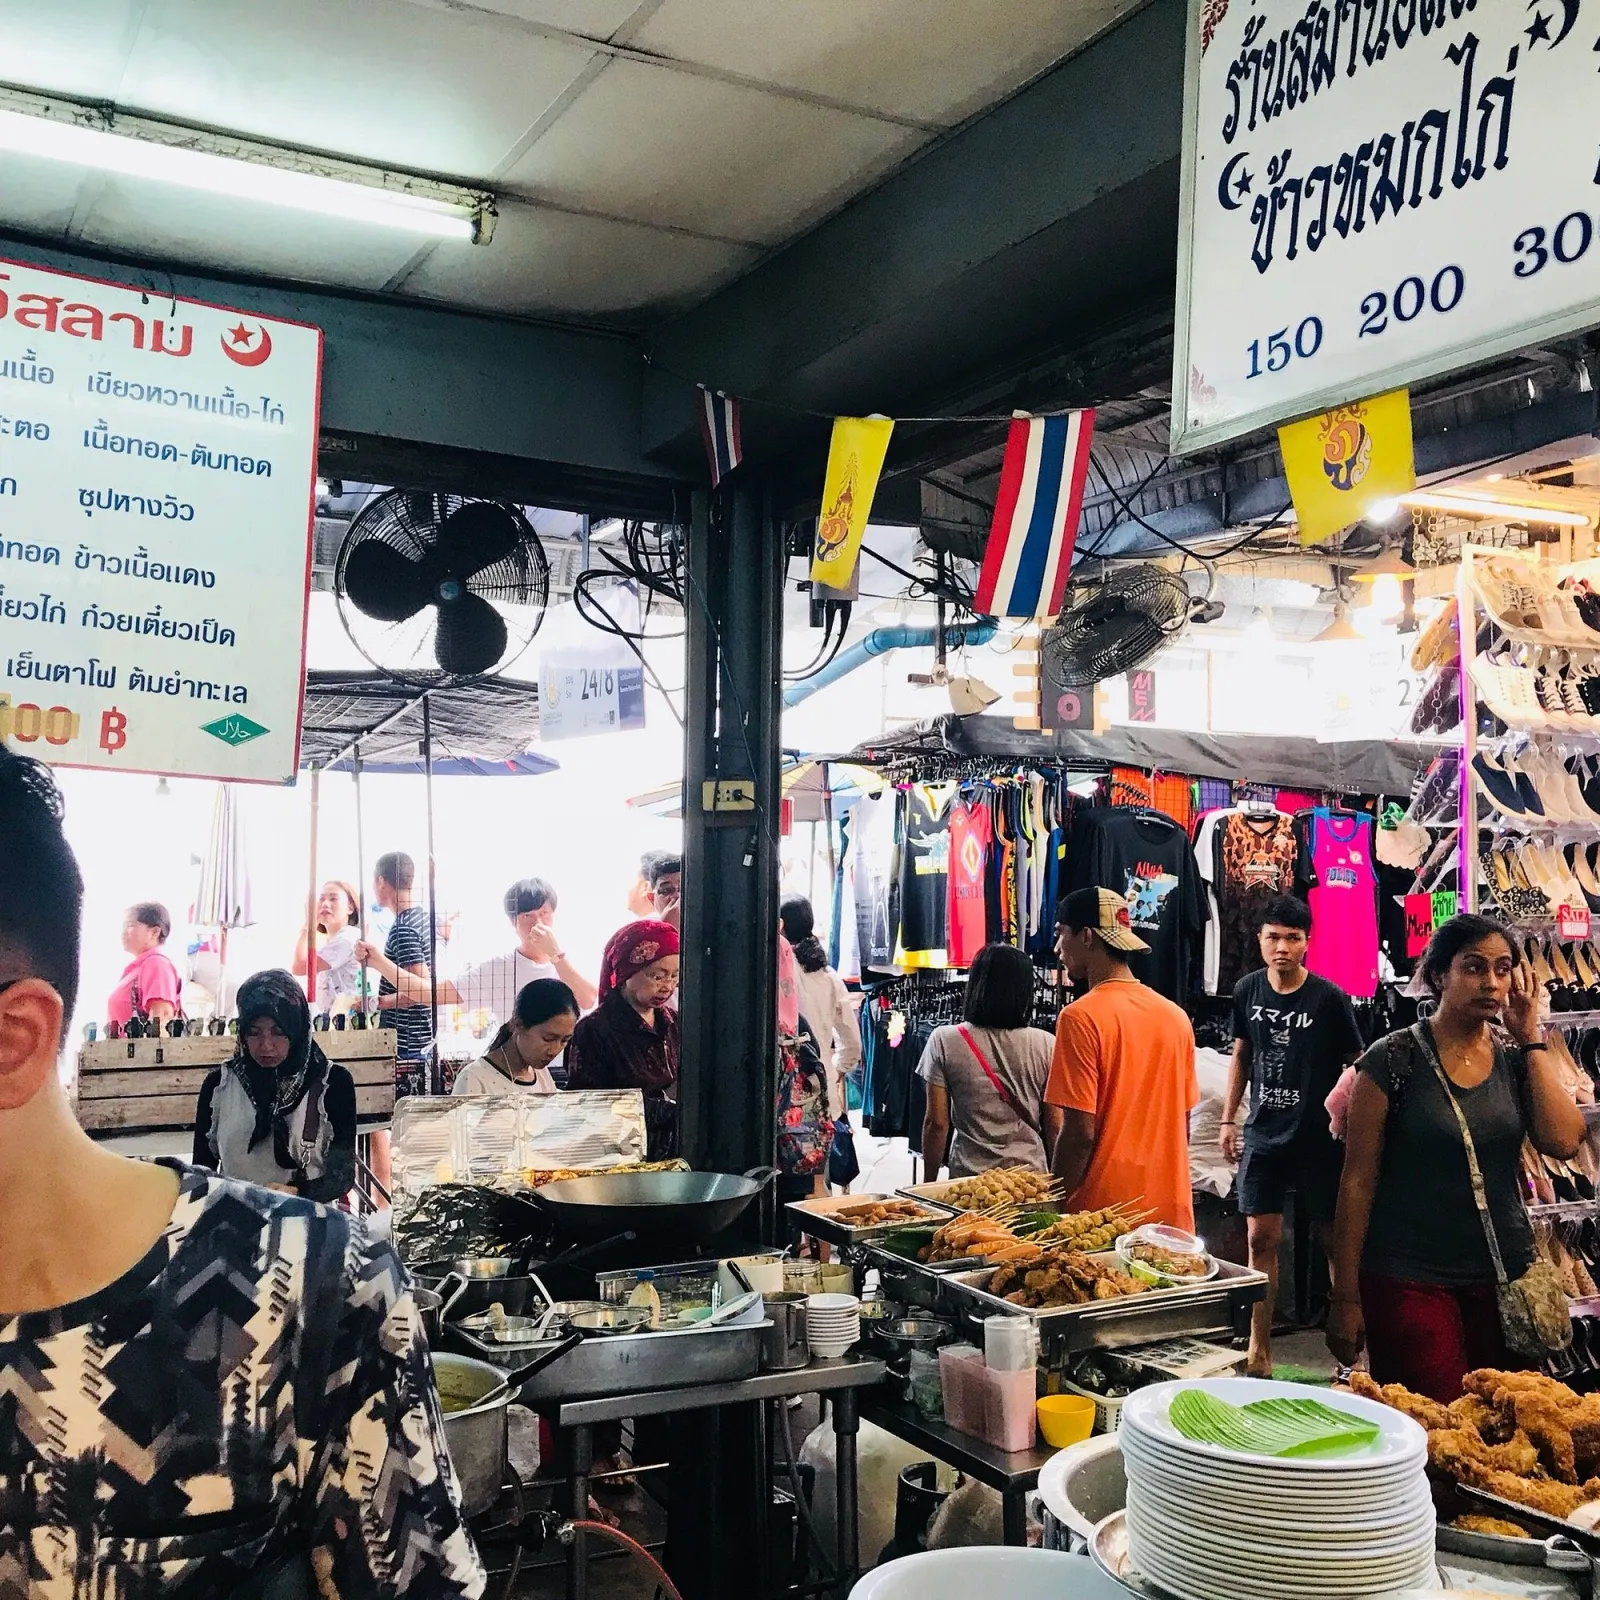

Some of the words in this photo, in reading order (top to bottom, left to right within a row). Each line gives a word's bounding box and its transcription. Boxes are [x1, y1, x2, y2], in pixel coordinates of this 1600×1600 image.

[1249, 32, 1519, 274] ข้าวหมกไก่
[0, 274, 193, 357] สลาม
[1246, 316, 1323, 380] 150
[1358, 265, 1464, 338] 200
[1513, 211, 1600, 278] 30
[87, 371, 284, 425] เขียวหวานเนื้อ-ไก่
[83, 418, 272, 477] เนื้อทอด-ตับทอด
[78, 488, 194, 522] ซุปหางวัว
[74, 543, 216, 588] ข้าวเนื้อแดง
[82, 604, 236, 647] ก๋วยเตี๋ยวเป็ด
[6, 651, 116, 689] เย็นตาโฟ
[128, 667, 248, 704] ต้มยำทะเล
[1131, 671, 1156, 721] MEN
[217, 719, 252, 739] حلال
[1561, 906, 1589, 921] SALE
[1250, 1005, 1313, 1028] スマイル
